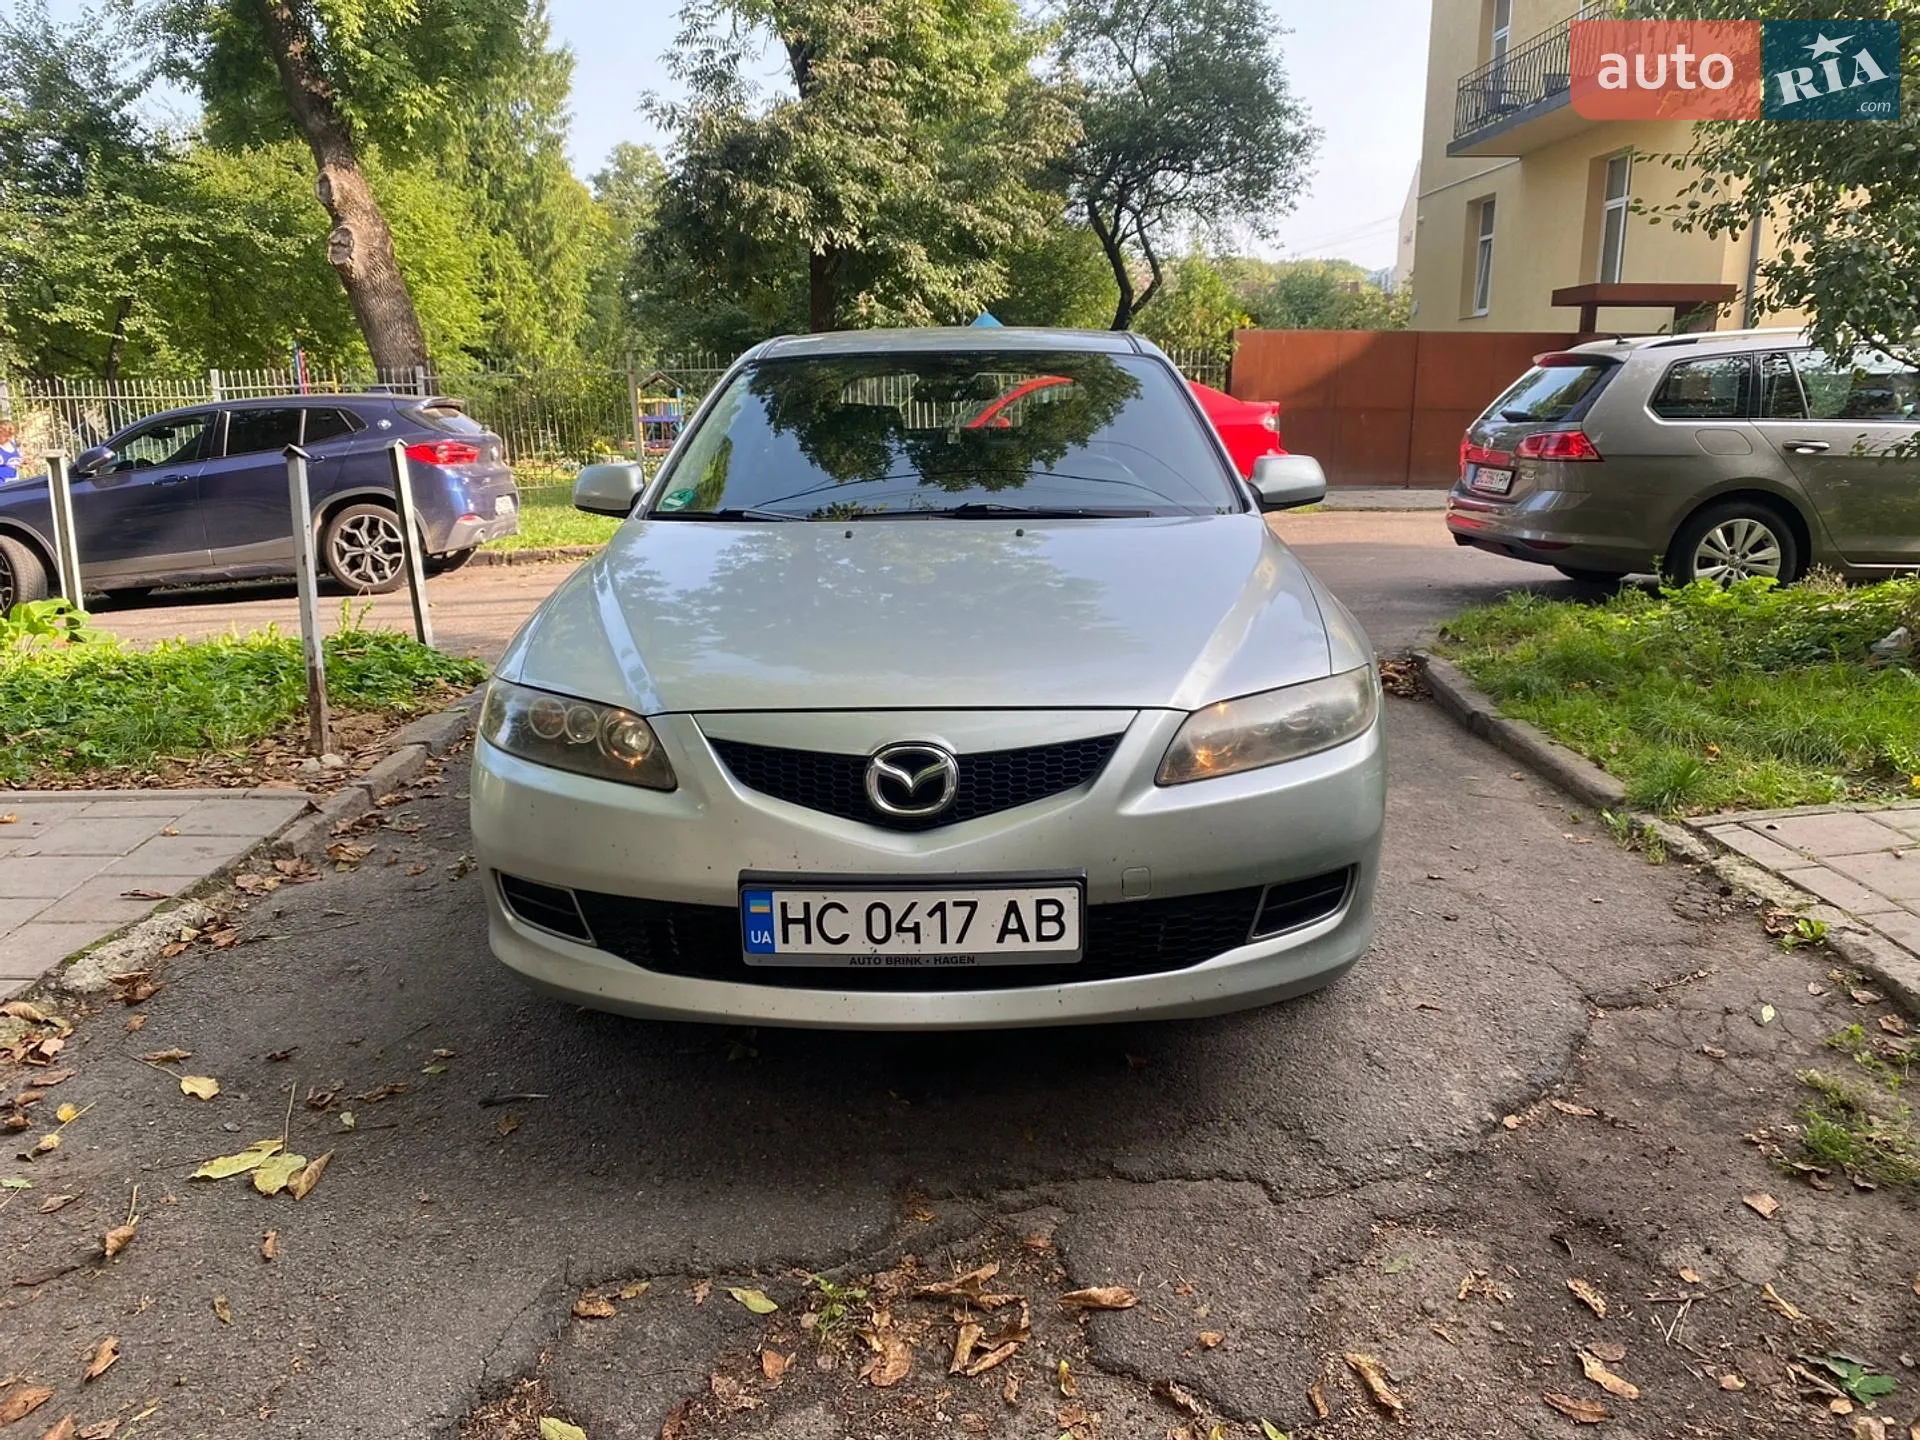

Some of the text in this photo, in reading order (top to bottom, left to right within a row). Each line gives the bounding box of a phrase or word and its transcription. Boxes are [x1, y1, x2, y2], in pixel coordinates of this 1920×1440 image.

[780, 898, 1066, 945] HC 0417 AB
[751, 930, 772, 944] UA
[849, 954, 976, 966] AUTO BRINK HAGEN
